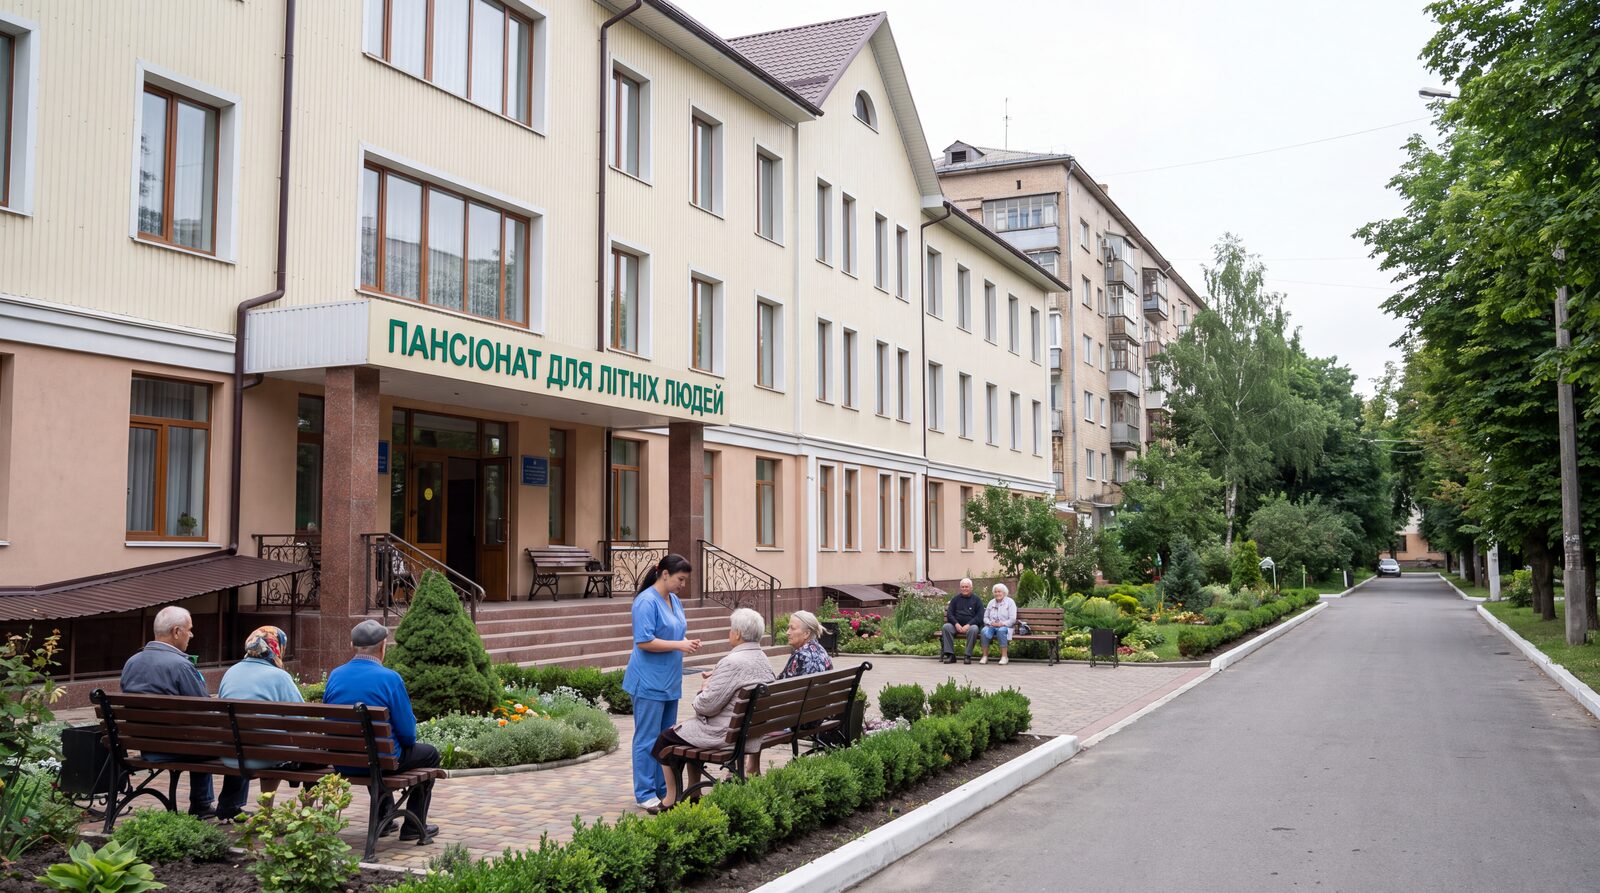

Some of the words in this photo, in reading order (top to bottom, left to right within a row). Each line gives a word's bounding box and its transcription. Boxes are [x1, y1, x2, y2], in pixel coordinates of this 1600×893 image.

[388, 318, 542, 380] ПАНСІОНАТ
[546, 353, 592, 391] ДЛЯ
[598, 364, 659, 403] ЛІТНІХ
[663, 378, 724, 416] ЛЮДЕЙ
